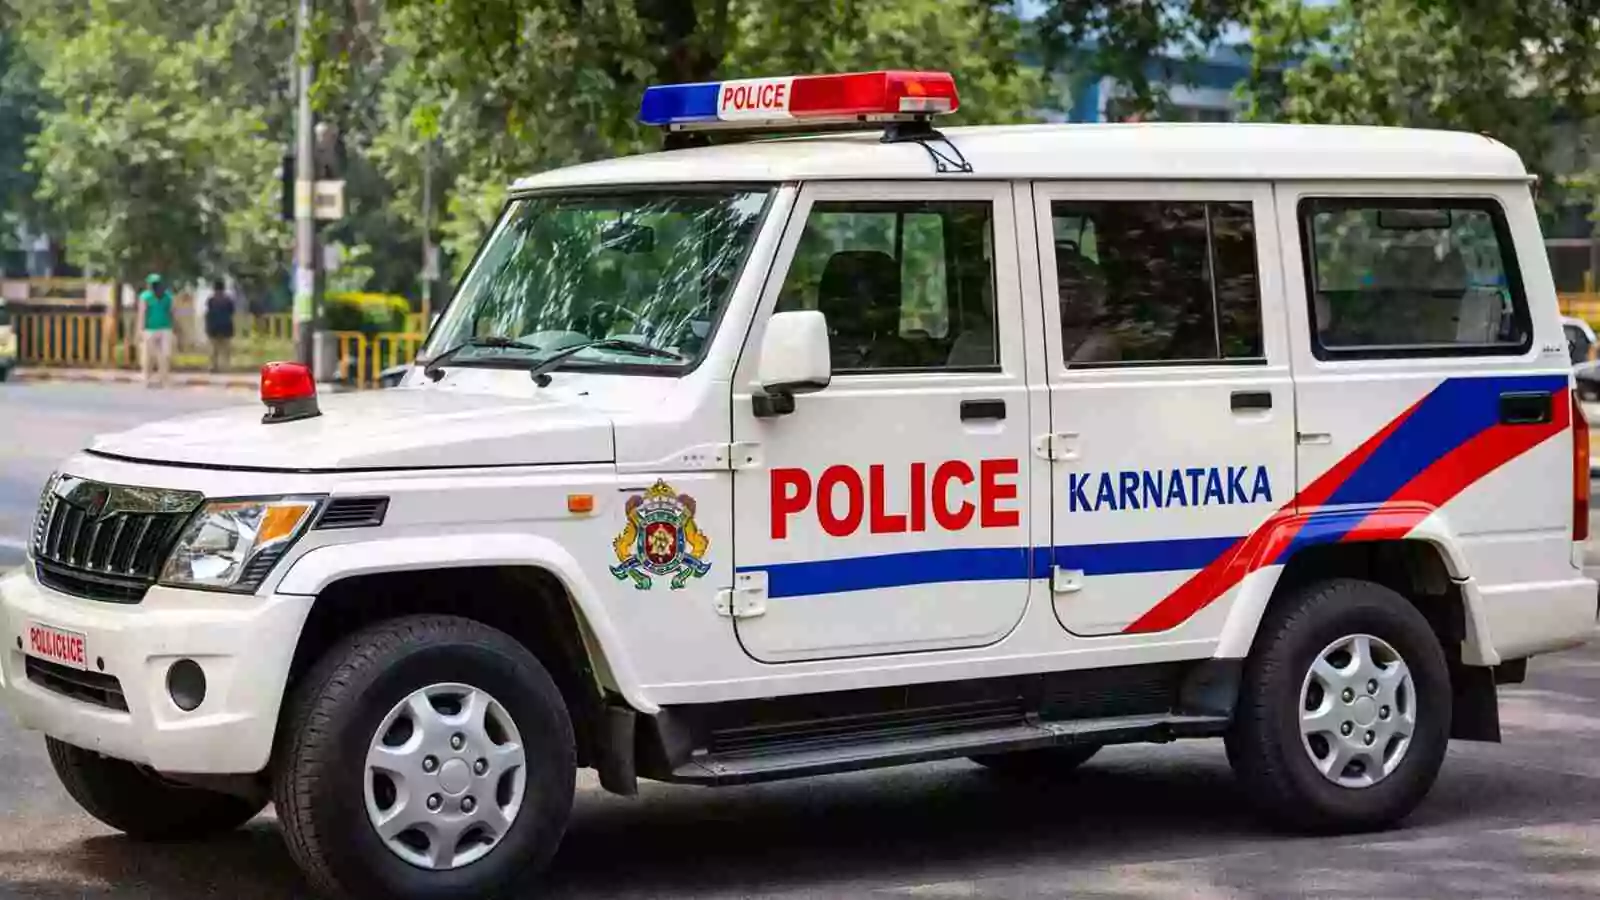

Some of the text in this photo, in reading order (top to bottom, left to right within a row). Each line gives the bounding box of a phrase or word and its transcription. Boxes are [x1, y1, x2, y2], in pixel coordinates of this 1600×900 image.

[722, 83, 786, 110] POLICE
[769, 458, 1020, 540] POLICE
[1068, 464, 1272, 513] KARNATAKA
